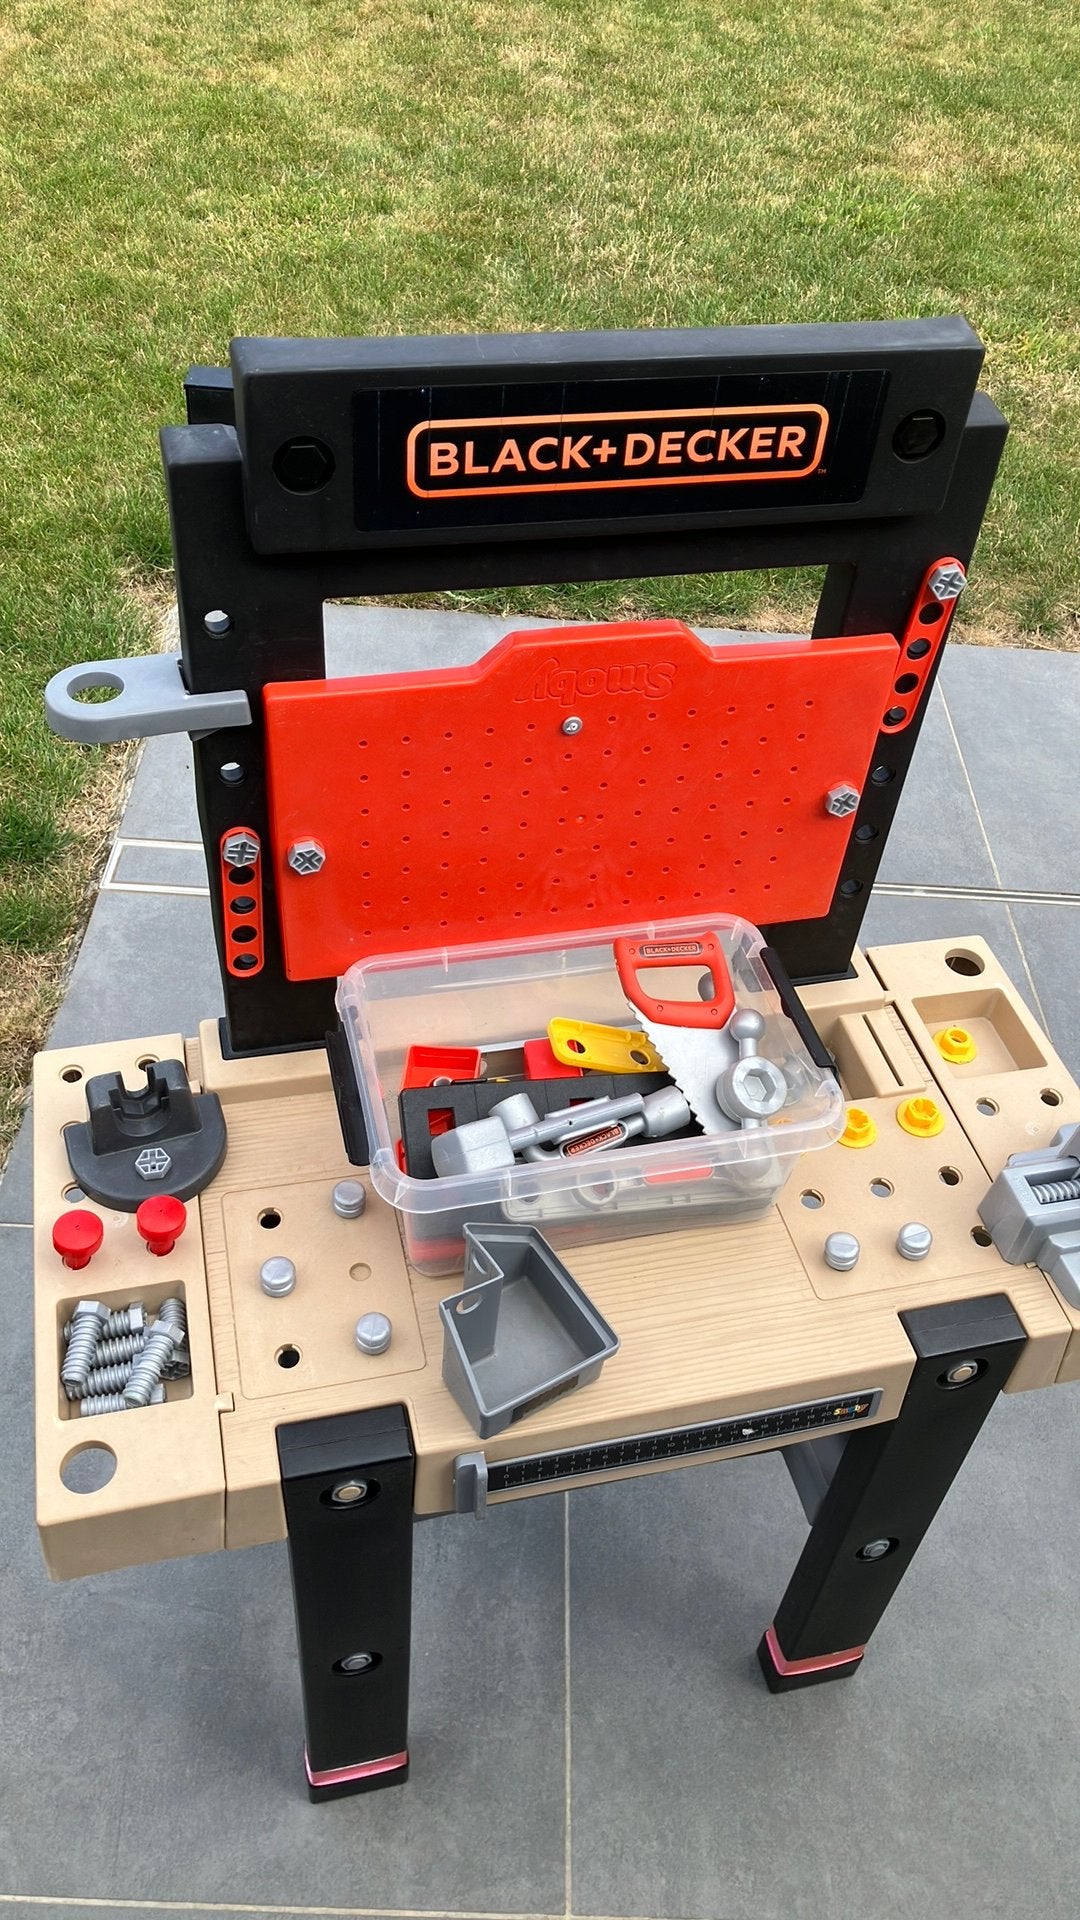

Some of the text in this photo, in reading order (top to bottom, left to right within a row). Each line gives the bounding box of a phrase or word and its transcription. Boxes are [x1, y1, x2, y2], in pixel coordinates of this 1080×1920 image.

[429, 426, 805, 476] BLACK+DECKER
[513, 656, 678, 708] Smoby
[645, 945, 698, 954] BLACK+DECKER
[569, 1127, 620, 1153] BLACK+DECKER
[833, 1404, 869, 1416] Smoby
